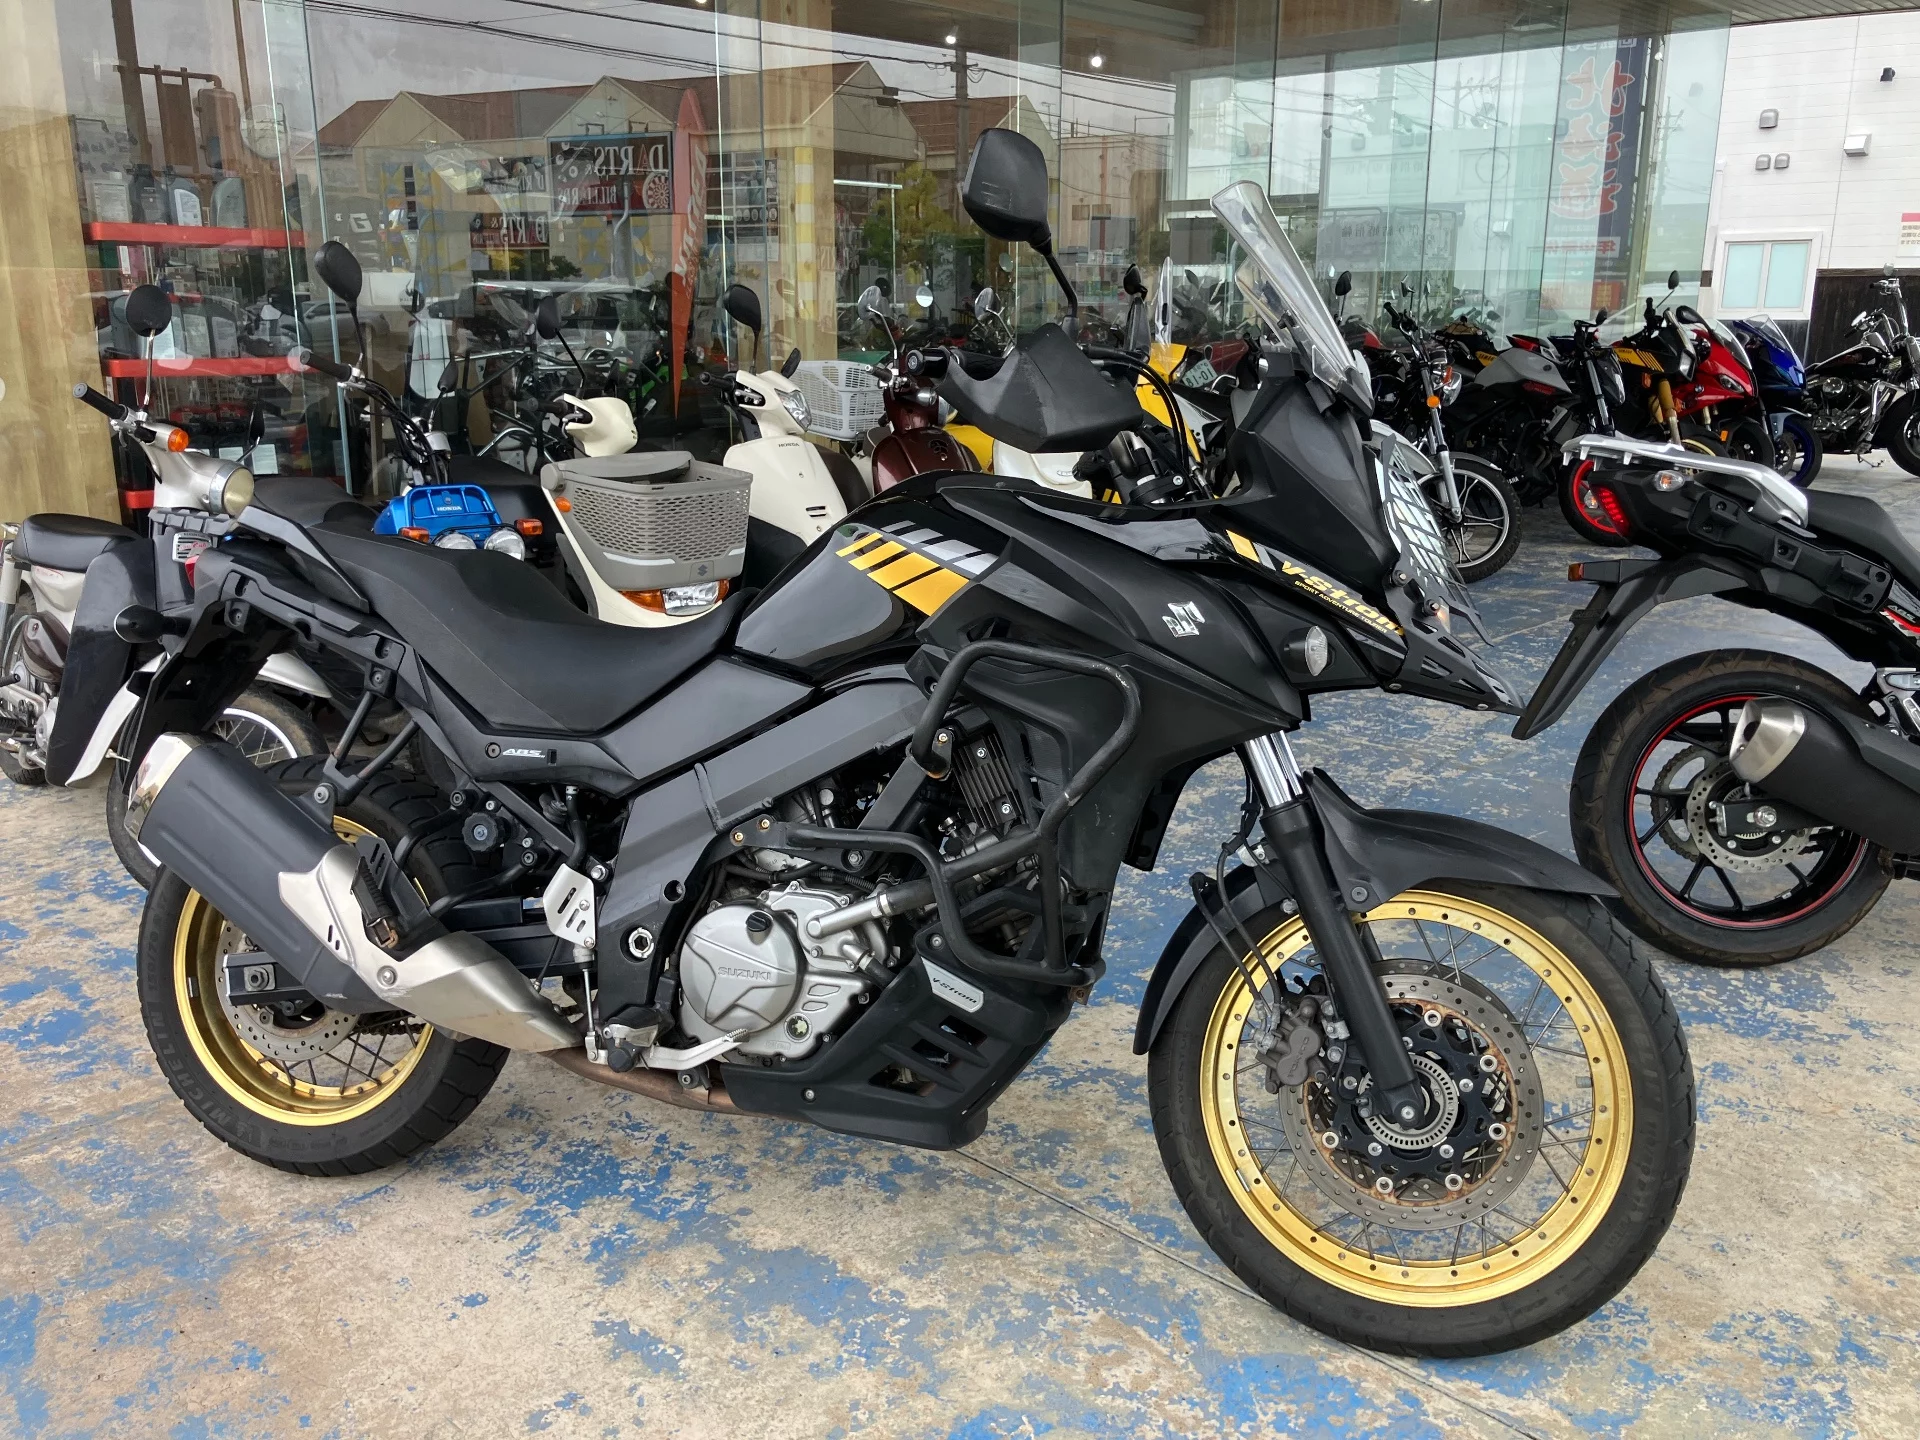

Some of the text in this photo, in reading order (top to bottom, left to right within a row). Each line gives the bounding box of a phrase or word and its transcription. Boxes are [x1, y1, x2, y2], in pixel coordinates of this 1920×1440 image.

[1294, 580, 1388, 634] SPORT ADVENTURE TOURER
[502, 748, 543, 758] ABS
[718, 966, 771, 980] SUZUKI
